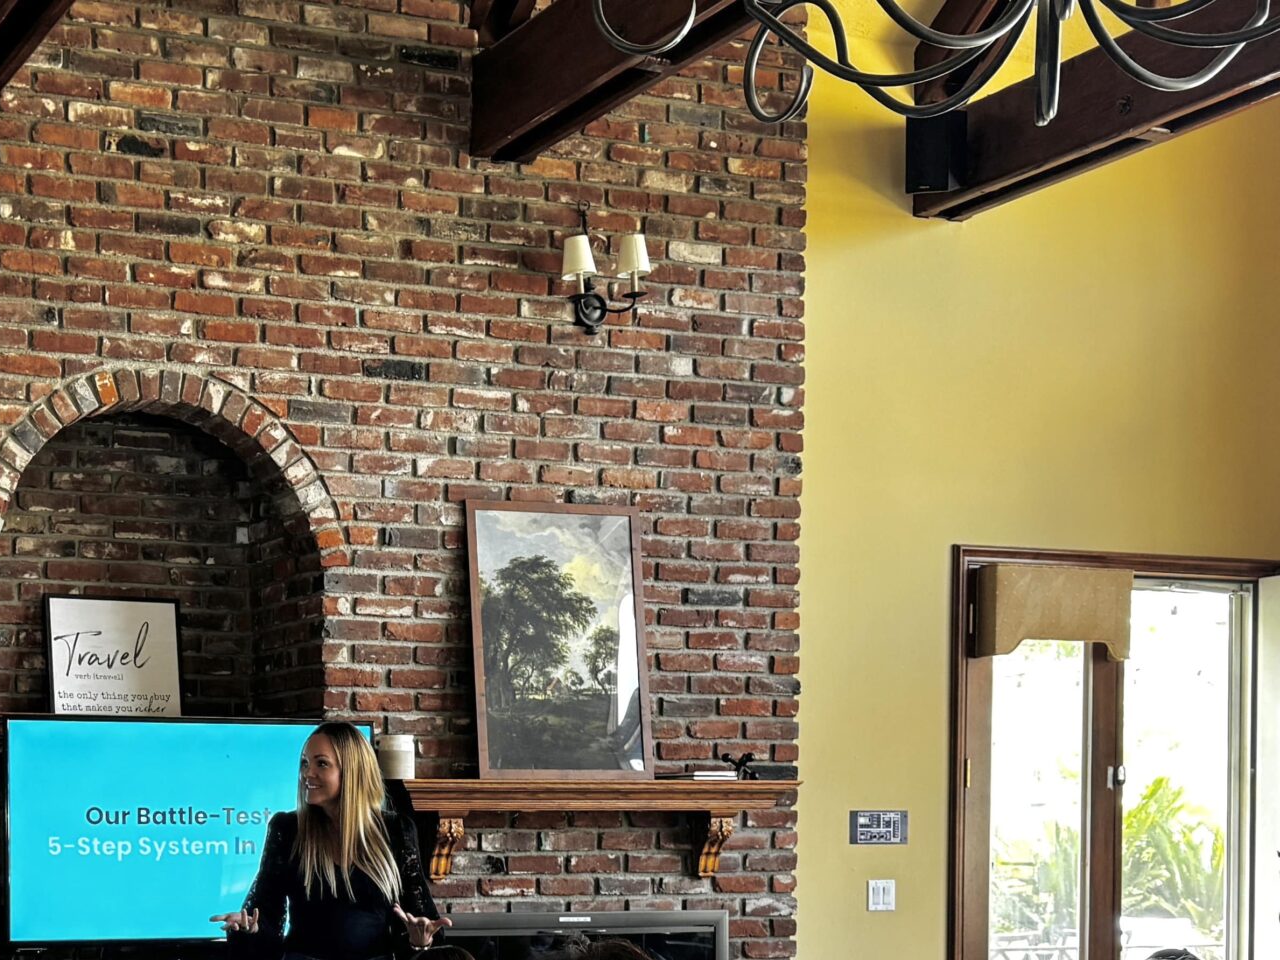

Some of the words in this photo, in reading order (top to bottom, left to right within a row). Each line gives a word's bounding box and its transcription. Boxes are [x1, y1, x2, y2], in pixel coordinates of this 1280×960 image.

[54, 621, 151, 677] Travel
[58, 690, 74, 699] the
[76, 691, 98, 702] only
[101, 691, 129, 702] thing
[131, 694, 148, 702] you
[154, 692, 171, 702] buy
[61, 703, 83, 711] that
[85, 703, 113, 712] makes
[115, 704, 133, 713] you
[135, 696, 167, 713] richer
[85, 806, 130, 825] Our
[137, 806, 271, 825] Battle-Test
[48, 836, 132, 861] 5-Step
[138, 836, 228, 861] System
[235, 836, 256, 855] In
